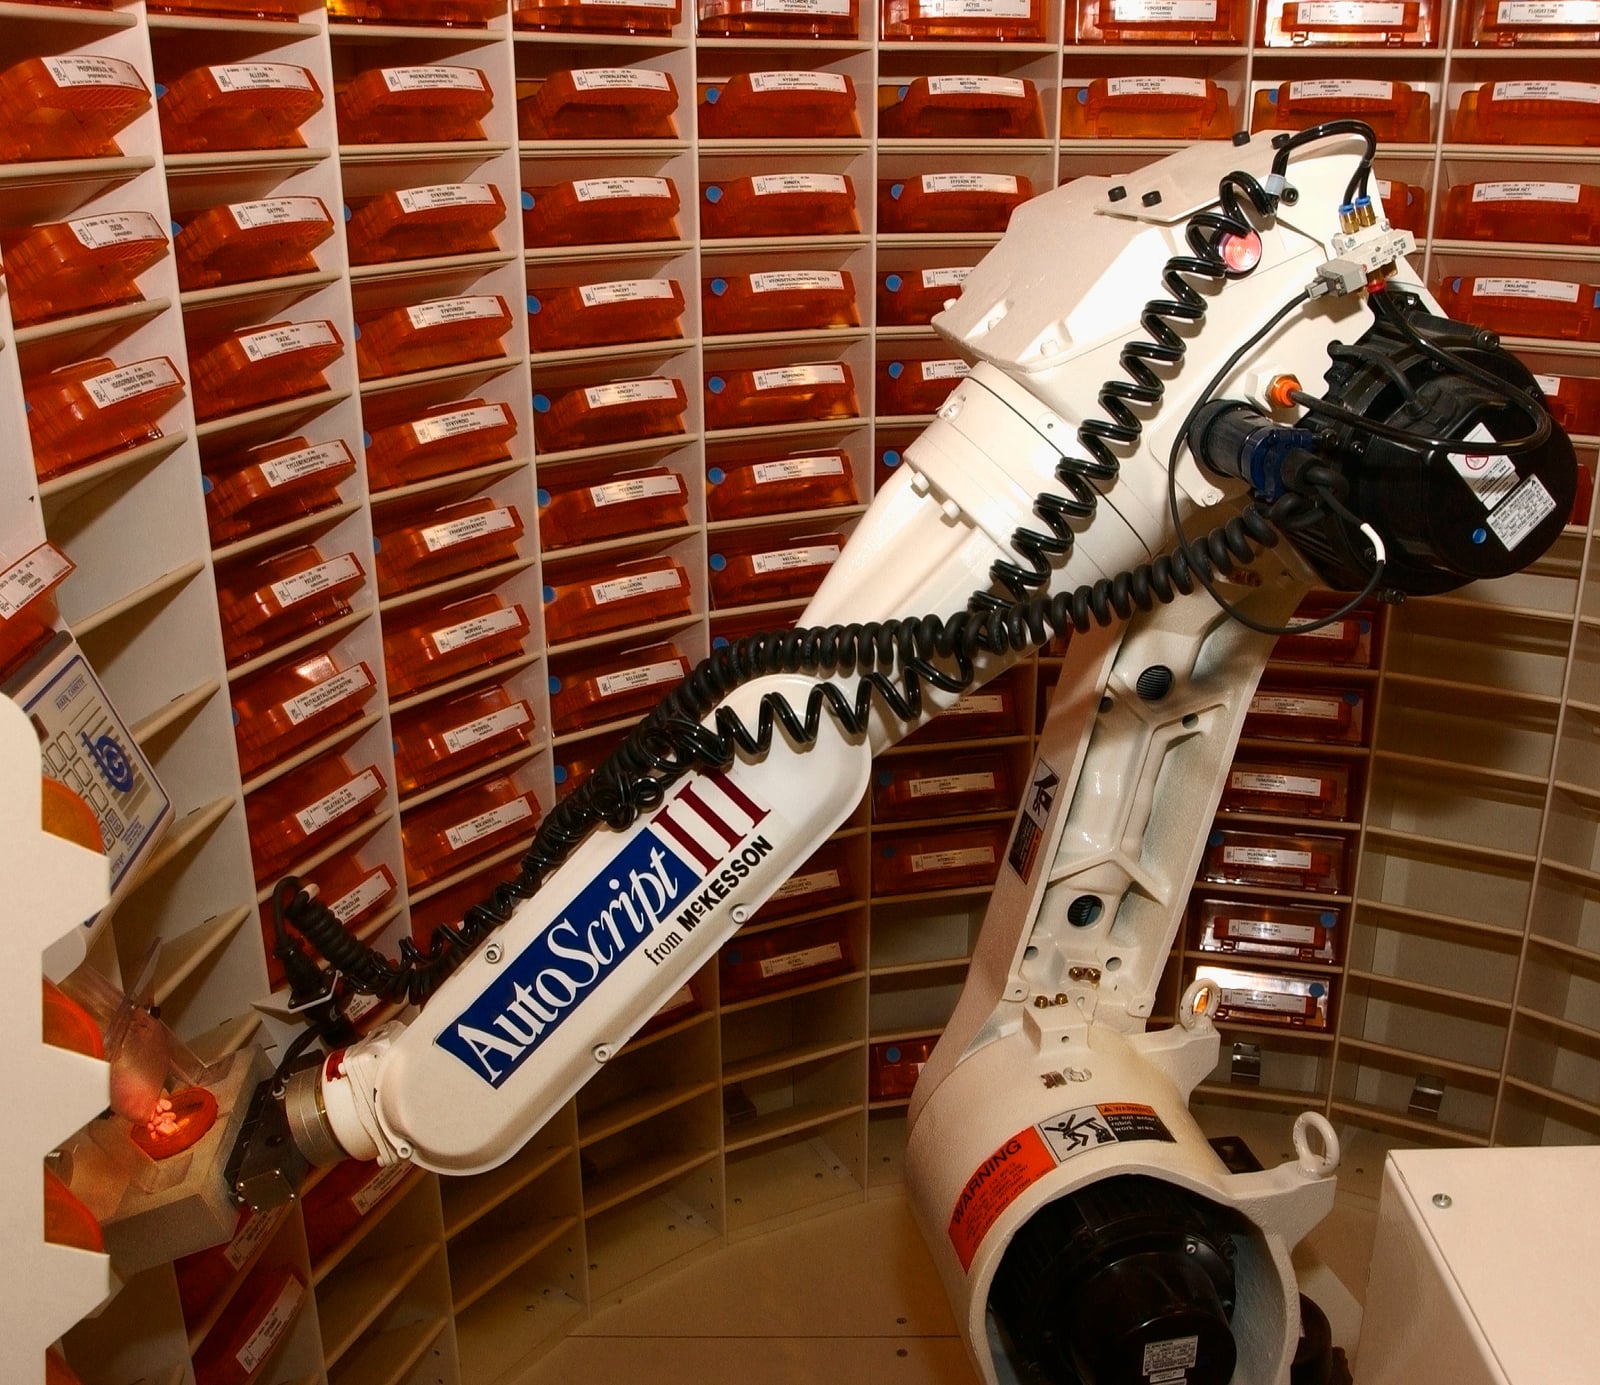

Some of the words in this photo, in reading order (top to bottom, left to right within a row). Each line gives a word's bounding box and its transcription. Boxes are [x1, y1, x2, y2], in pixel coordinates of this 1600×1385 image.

[456, 846, 679, 1083] AutoScript
[644, 928, 684, 966] from
[677, 834, 774, 933] McKESSON
[954, 1139, 1022, 1225] WARNING
